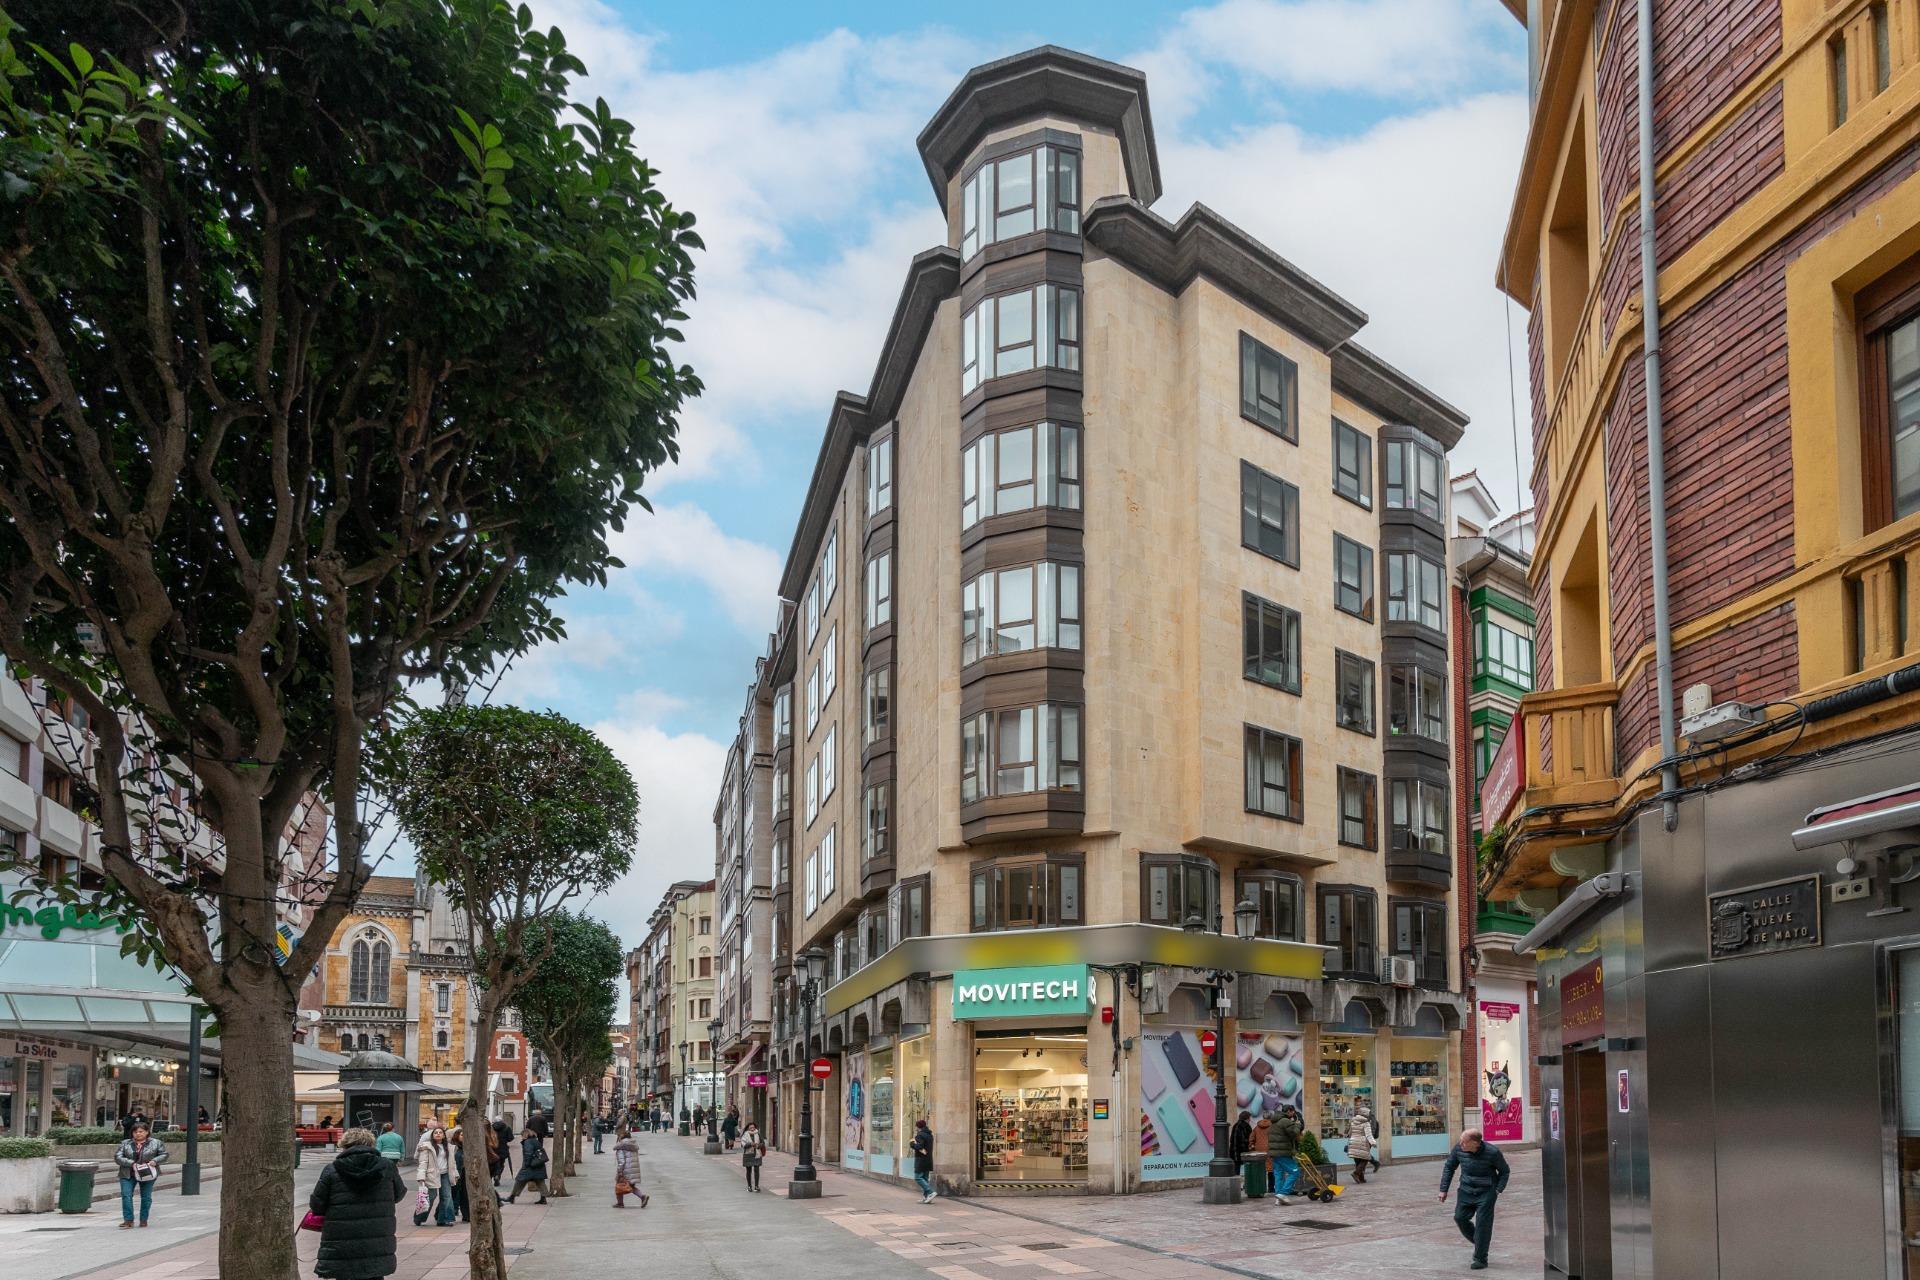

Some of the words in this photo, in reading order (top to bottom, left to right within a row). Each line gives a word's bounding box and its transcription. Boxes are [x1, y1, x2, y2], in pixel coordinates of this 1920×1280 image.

[1753, 894, 1792, 909] CALLE
[1753, 912, 1793, 927] NUEVE
[1753, 932, 1767, 943] DE
[1775, 927, 1808, 940] MAYO
[959, 980, 1078, 1003] MOVITECH
[15, 1042, 29, 1054] La
